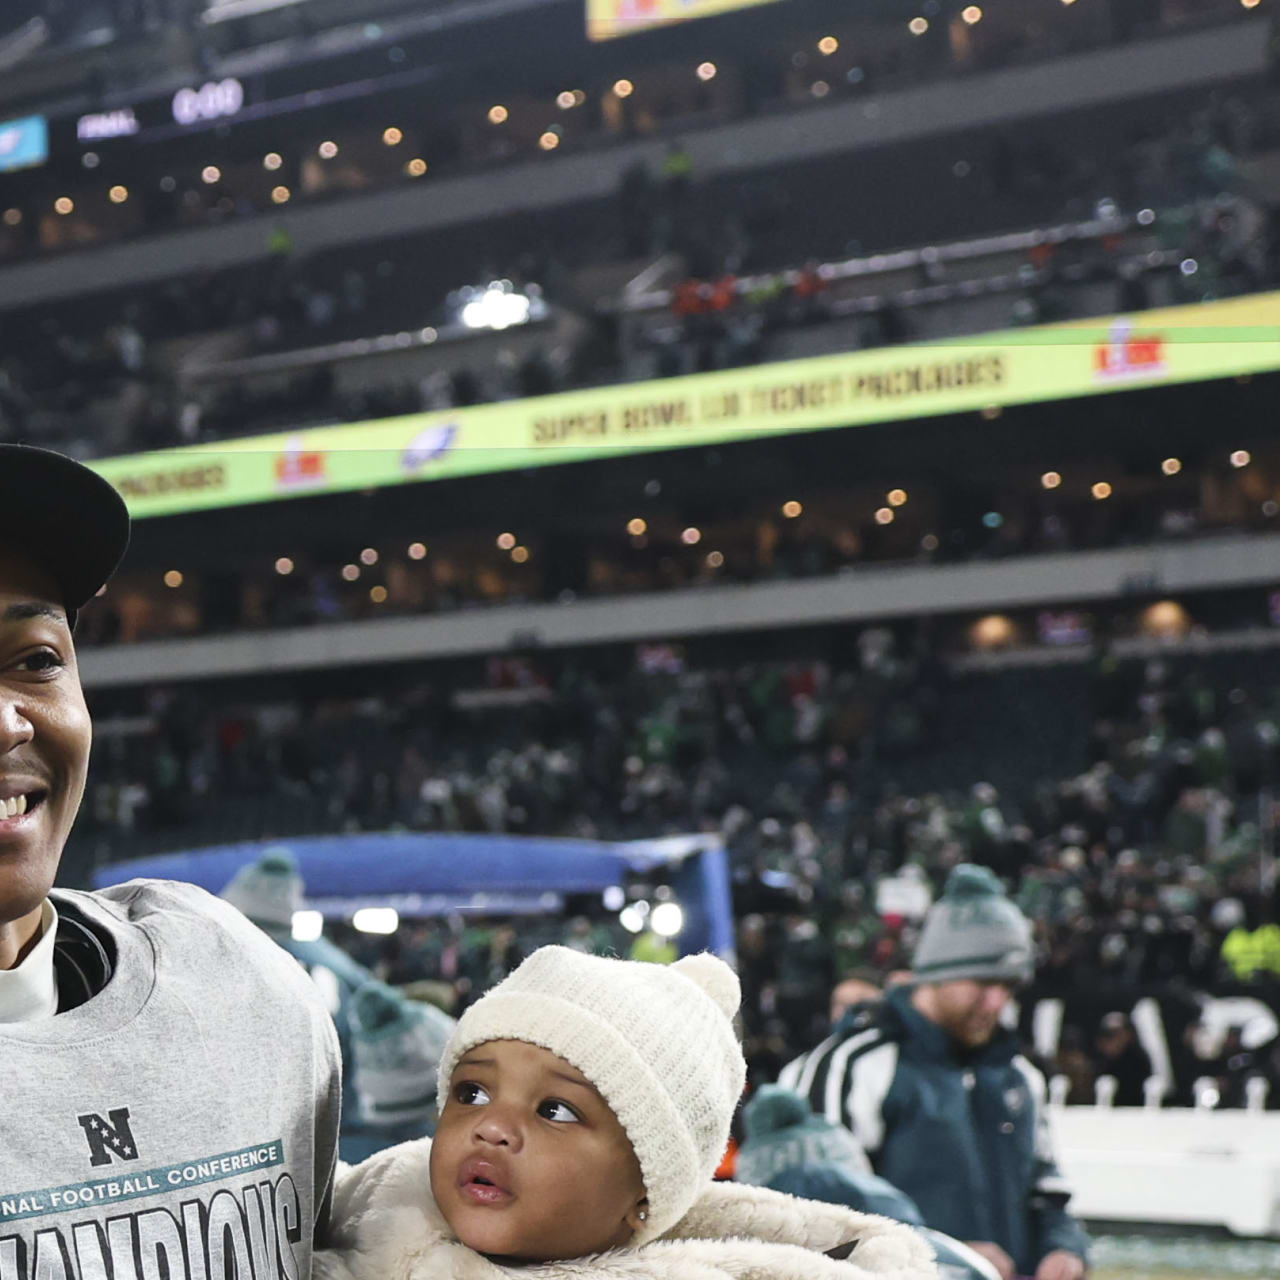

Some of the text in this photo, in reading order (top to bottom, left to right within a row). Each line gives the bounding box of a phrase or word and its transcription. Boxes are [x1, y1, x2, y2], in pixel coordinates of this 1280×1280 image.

[855, 355, 1004, 400] PACKAGES
[49, 1168, 160, 1207] FOOTBALL
[166, 1144, 279, 1185] CONFERENCE
